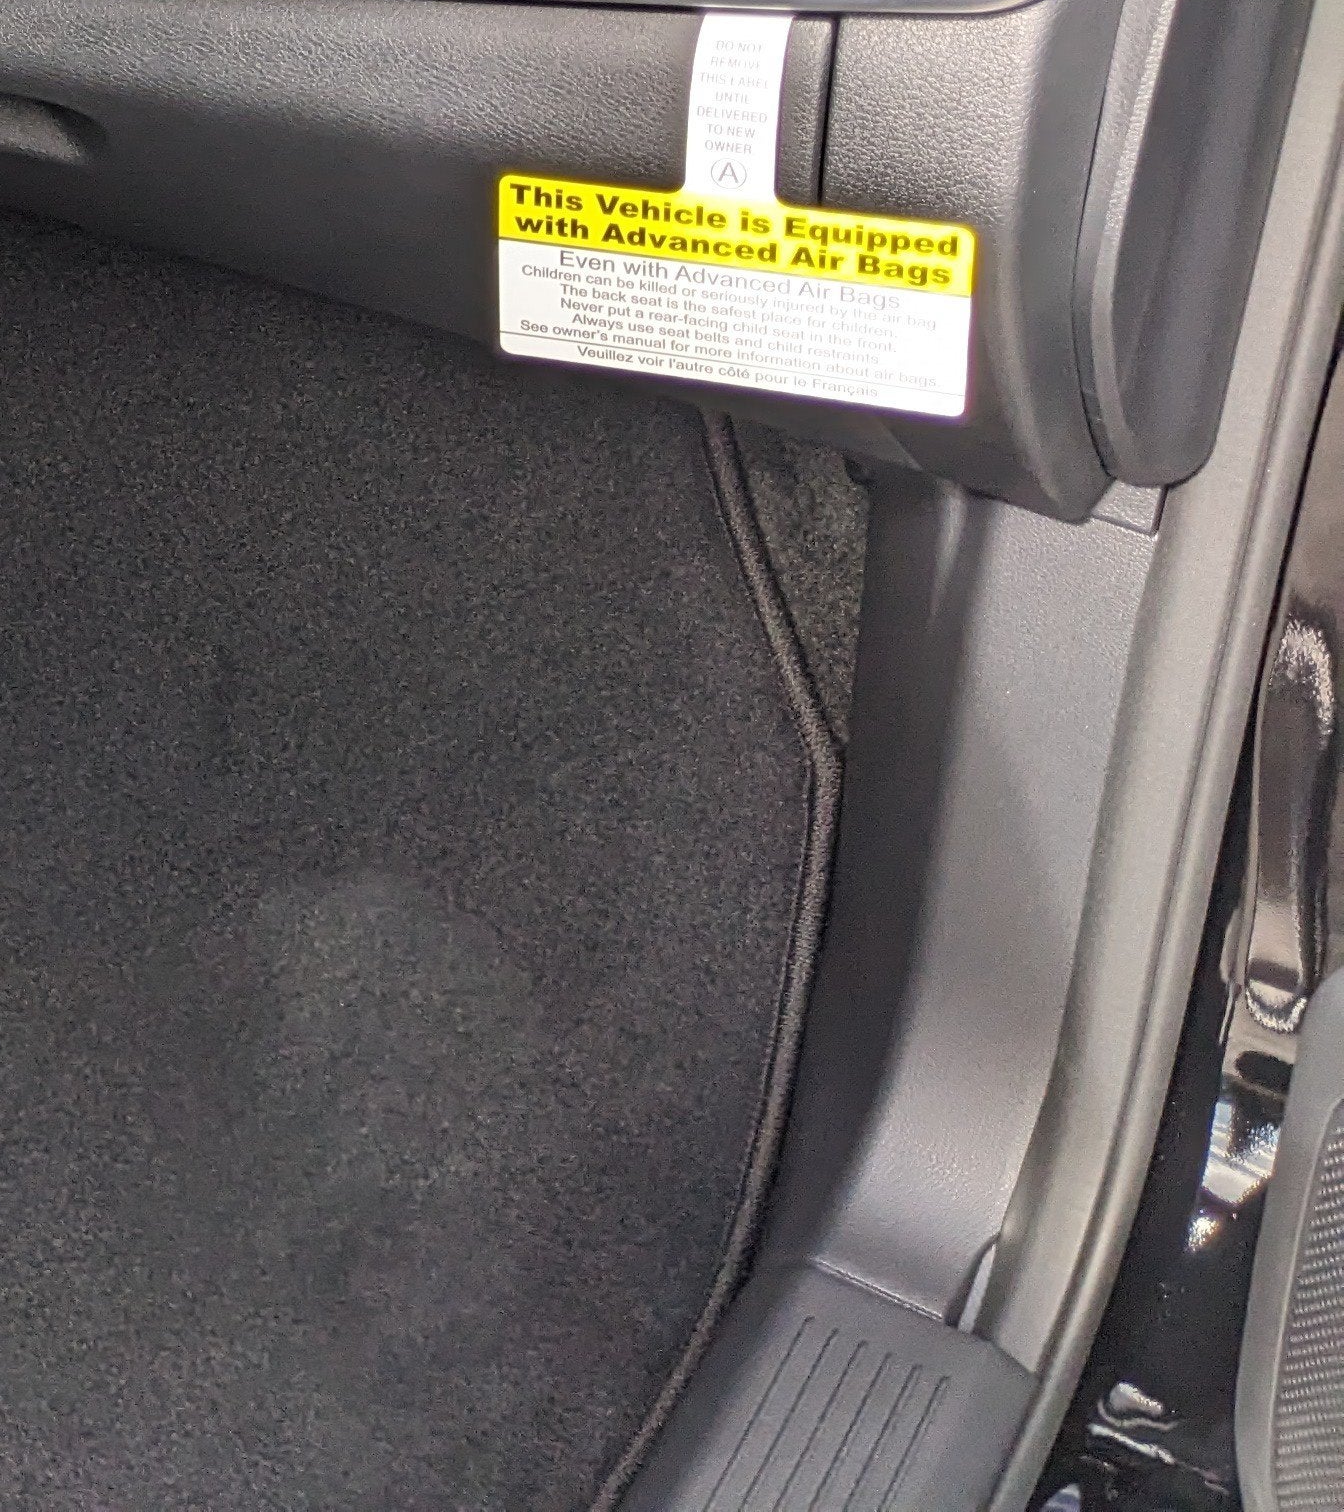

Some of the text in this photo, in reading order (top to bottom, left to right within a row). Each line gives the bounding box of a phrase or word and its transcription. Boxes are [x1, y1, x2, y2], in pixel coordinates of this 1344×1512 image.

[700, 72, 768, 89] THIS LABEL
[711, 56, 760, 69] REMOVE
[697, 106, 767, 123] DELIVERED
[716, 92, 750, 104] UNTIL
[705, 140, 752, 154] OWNER
[707, 124, 755, 138] TO NEW
[718, 162, 738, 183] A
[510, 183, 958, 257] This Vehicle is Equipped
[514, 215, 951, 287] with Advanced Air Bags
[522, 265, 936, 330] Children can be killed or seriously injured by the air bag
[560, 250, 900, 310] Even with Advanced Air Bags
[561, 283, 897, 338] The back seat is the safest place for children.
[561, 298, 897, 353] Never put a rear-facing child seat in the front.
[520, 320, 548, 333] See
[552, 326, 608, 341] owner's
[613, 334, 666, 349] manual
[671, 340, 690, 352] for
[694, 345, 732, 358] more
[738, 349, 820, 371] information
[826, 363, 869, 377] about
[875, 370, 894, 380] air
[572, 313, 879, 365] Always use seat belts and child restraints
[577, 346, 878, 398] Veuillez voir l'autre côté pour le Français
